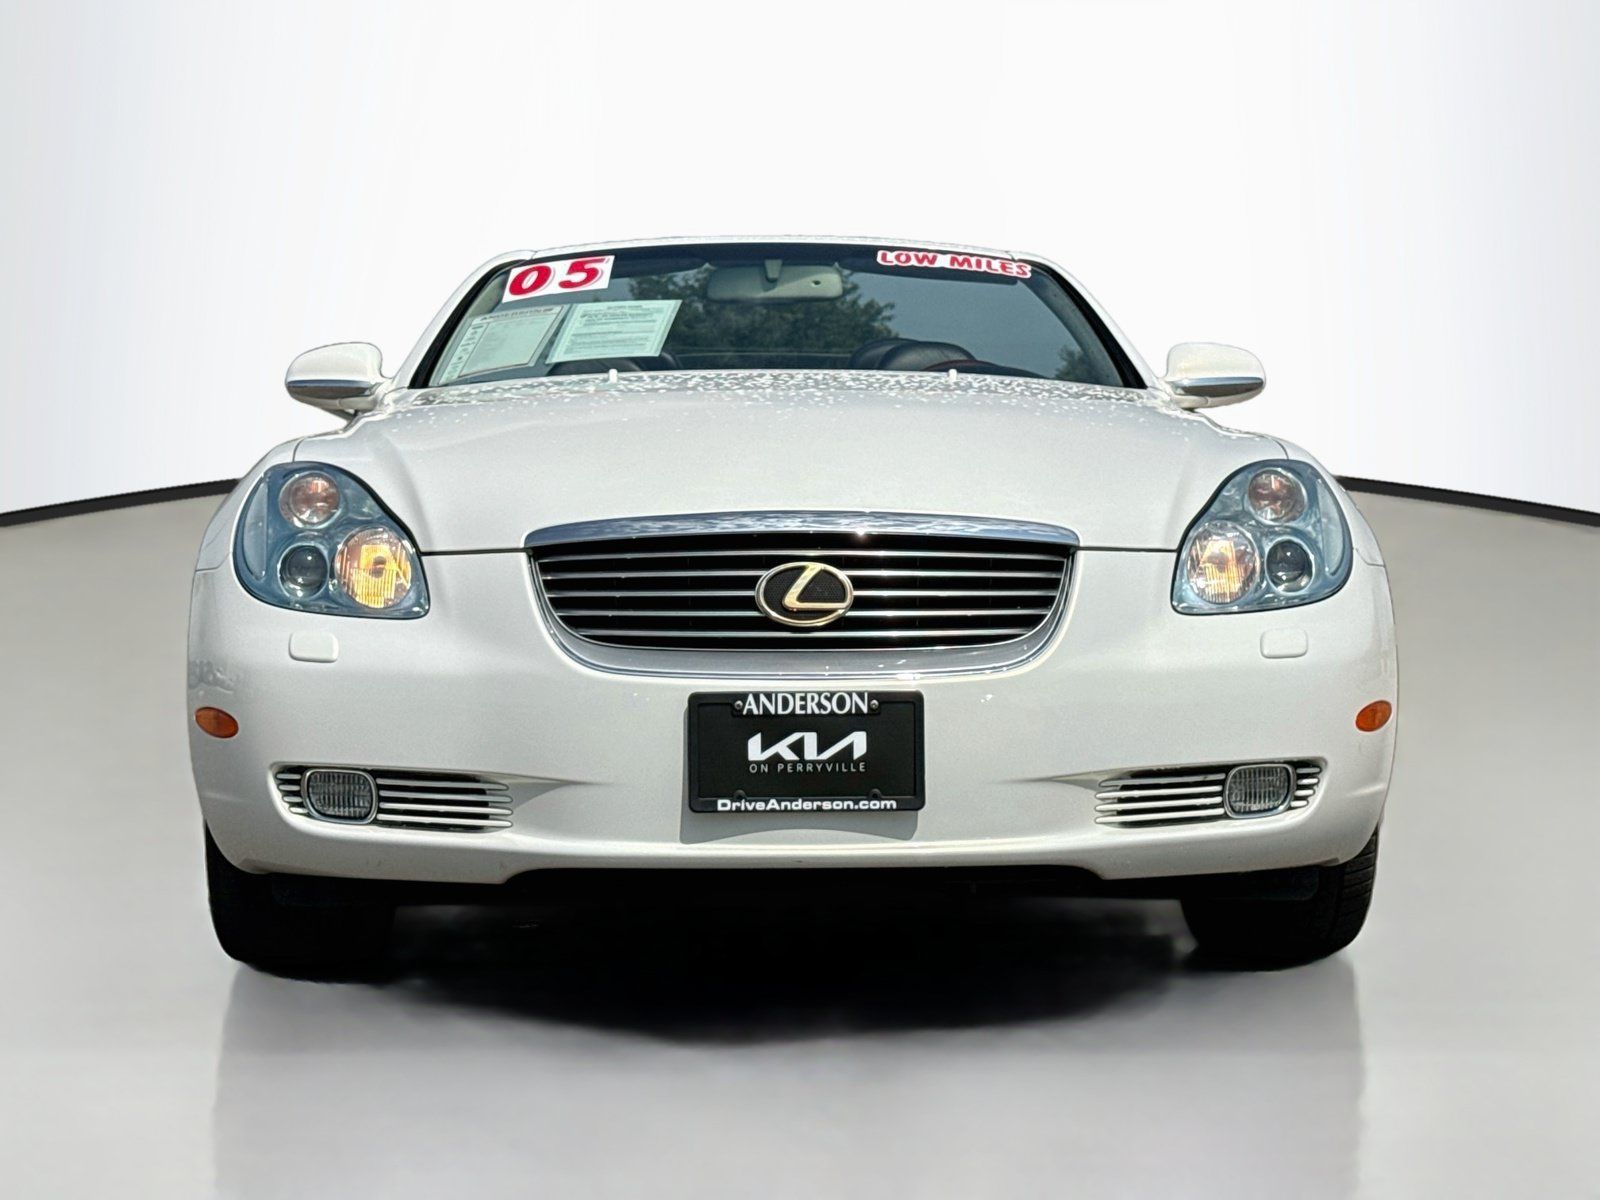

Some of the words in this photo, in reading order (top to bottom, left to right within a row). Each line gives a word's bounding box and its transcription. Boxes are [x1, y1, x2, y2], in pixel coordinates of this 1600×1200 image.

[881, 251, 938, 266] LOW
[949, 256, 1029, 277] MILES
[742, 692, 869, 715] ANDERSON
[747, 731, 867, 761] KIA
[749, 763, 768, 773] ON
[777, 762, 866, 772] PERRYVILLE
[717, 798, 898, 811] DriveAnderson.com
